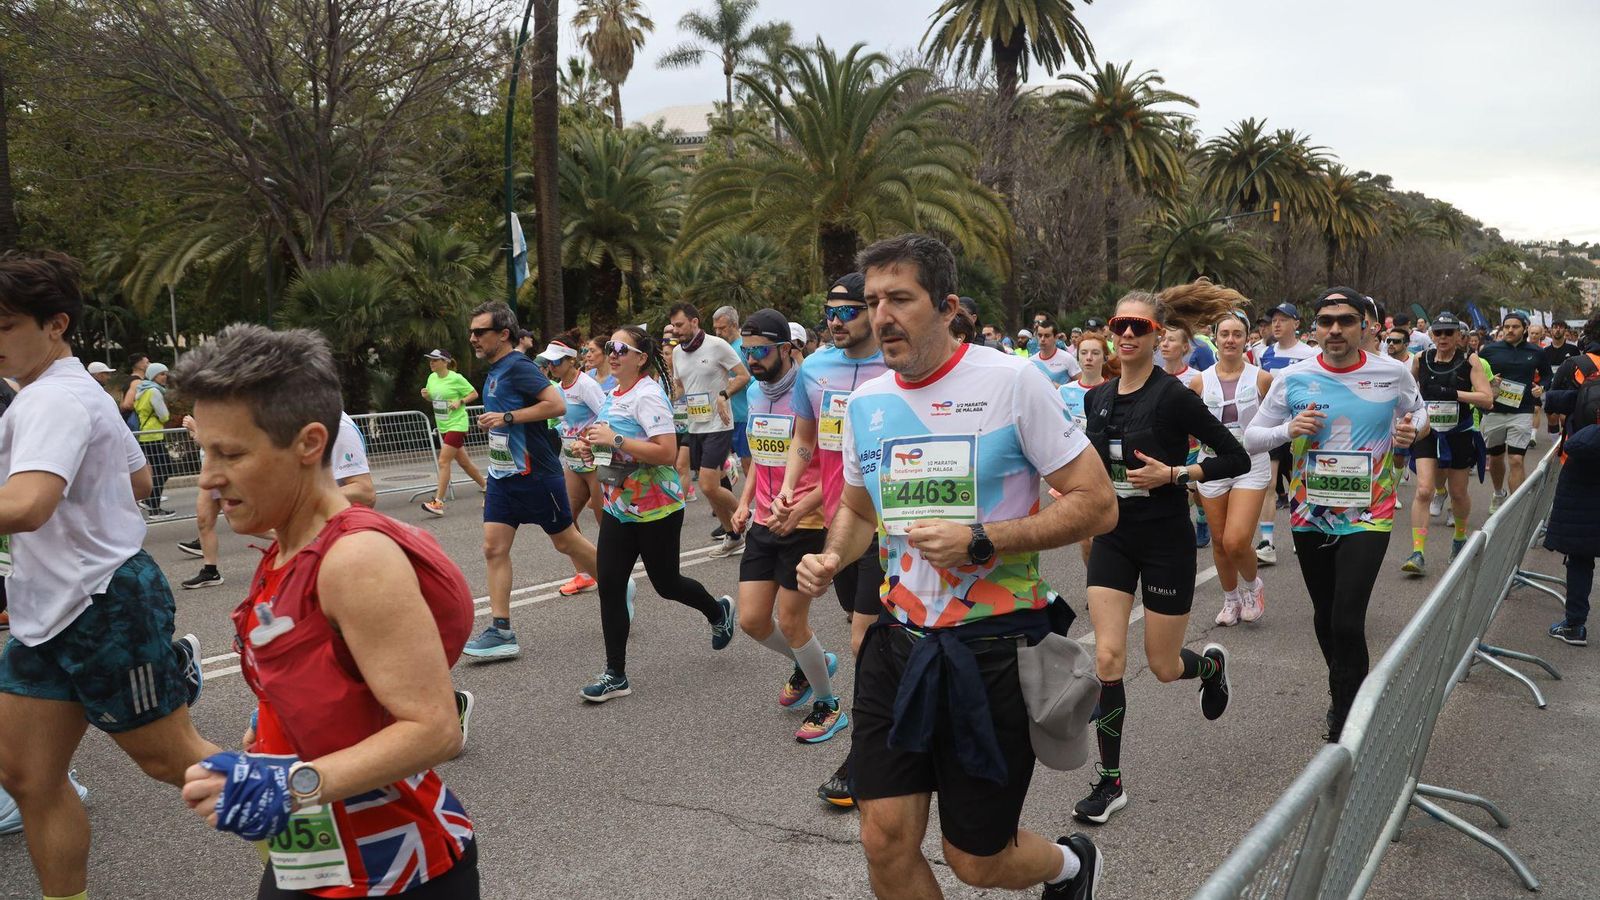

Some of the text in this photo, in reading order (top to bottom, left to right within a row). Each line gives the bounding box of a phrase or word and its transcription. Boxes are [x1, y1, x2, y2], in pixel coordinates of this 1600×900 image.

[1293, 403, 1329, 411] Málga
[756, 439, 785, 453] 3669
[1320, 476, 1361, 491] 3926
[896, 479, 957, 504] 4463
[1147, 584, 1177, 595] LES MILLS
